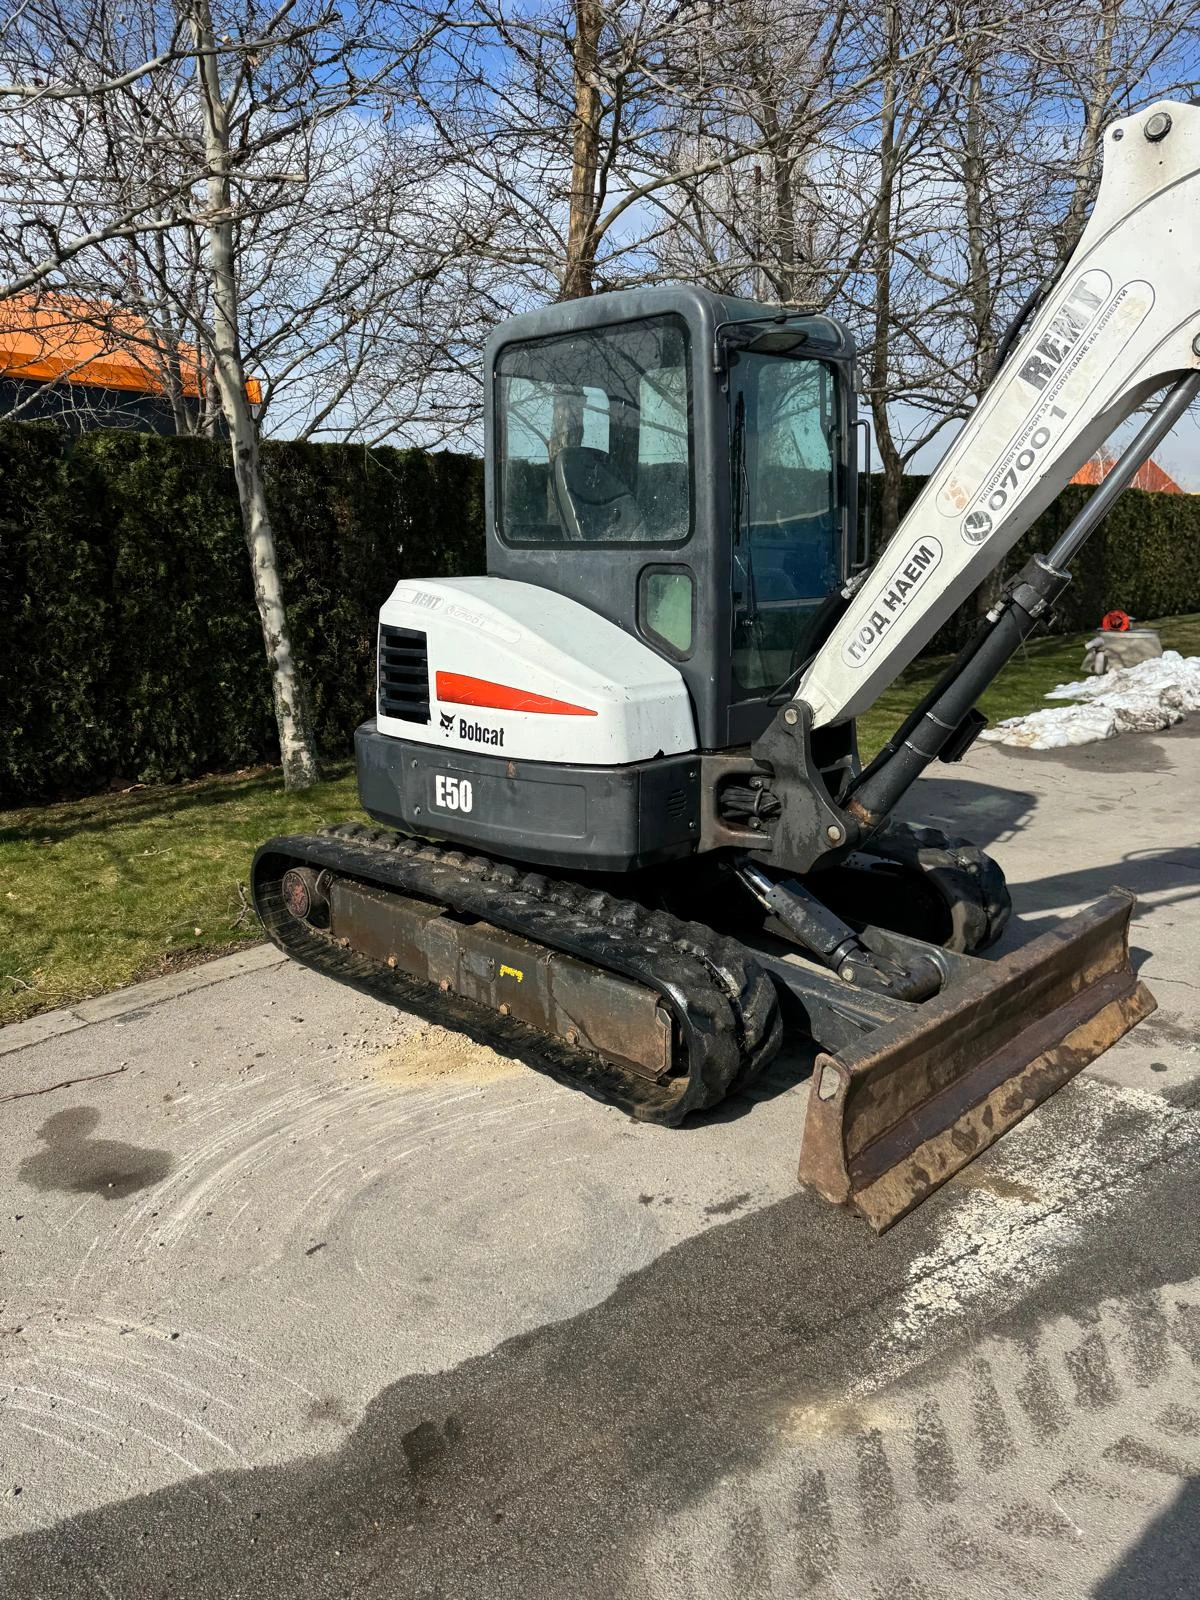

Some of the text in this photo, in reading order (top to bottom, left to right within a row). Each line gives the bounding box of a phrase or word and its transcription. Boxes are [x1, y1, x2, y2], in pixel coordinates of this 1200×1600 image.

[1018, 280, 1103, 391] RENT
[980, 452, 1016, 503] НАЦИОНАЛЕН
[1015, 413, 1043, 451] ТЕЛЕФОН
[1040, 403, 1050, 414] ЗА
[1050, 345, 1090, 402] ОБСЛУЖВАНЕ
[1089, 331, 1101, 345] НА
[1099, 289, 1128, 331] КЛИЕНТИ
[988, 427, 1051, 511] 0700
[411, 592, 442, 610] RENT
[847, 545, 935, 660] ПОД НАЕМ
[459, 718, 504, 747] Bobcat
[435, 774, 473, 813] E50
